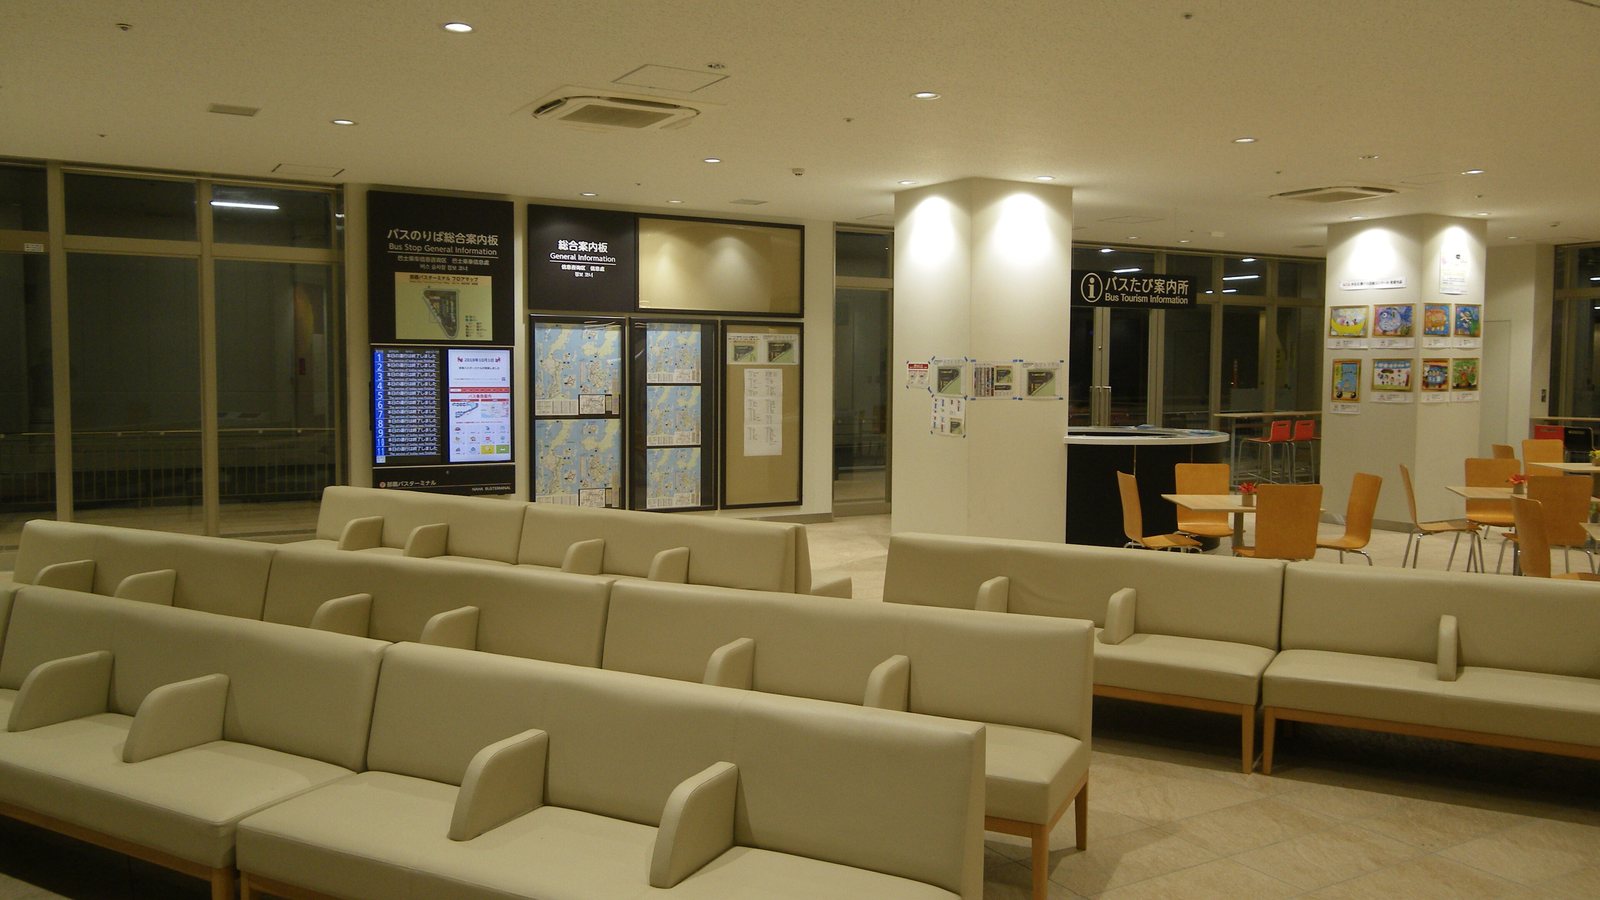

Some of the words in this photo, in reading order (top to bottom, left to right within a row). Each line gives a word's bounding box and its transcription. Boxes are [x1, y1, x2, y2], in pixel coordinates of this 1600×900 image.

[387, 228, 499, 246] バスのりば総合案内板
[388, 242, 403, 251] Bus
[404, 243, 422, 253] Stop
[424, 244, 453, 254] General
[455, 246, 498, 256] Information
[557, 239, 608, 253] 総合案内板
[549, 252, 577, 260] General
[577, 254, 616, 263] Information
[1105, 276, 1189, 296] バスたび案内所
[1104, 292, 1120, 303] Bus
[1121, 293, 1148, 304] Tourism
[1149, 294, 1189, 305] Information
[376, 353, 381, 362] 1
[377, 362, 383, 372] 2
[377, 372, 383, 381] 3
[377, 382, 383, 390] 4
[377, 391, 383, 400] 5
[377, 400, 383, 409] 6
[378, 410, 383, 418] 7
[377, 419, 384, 428] 8
[378, 428, 384, 437] 9
